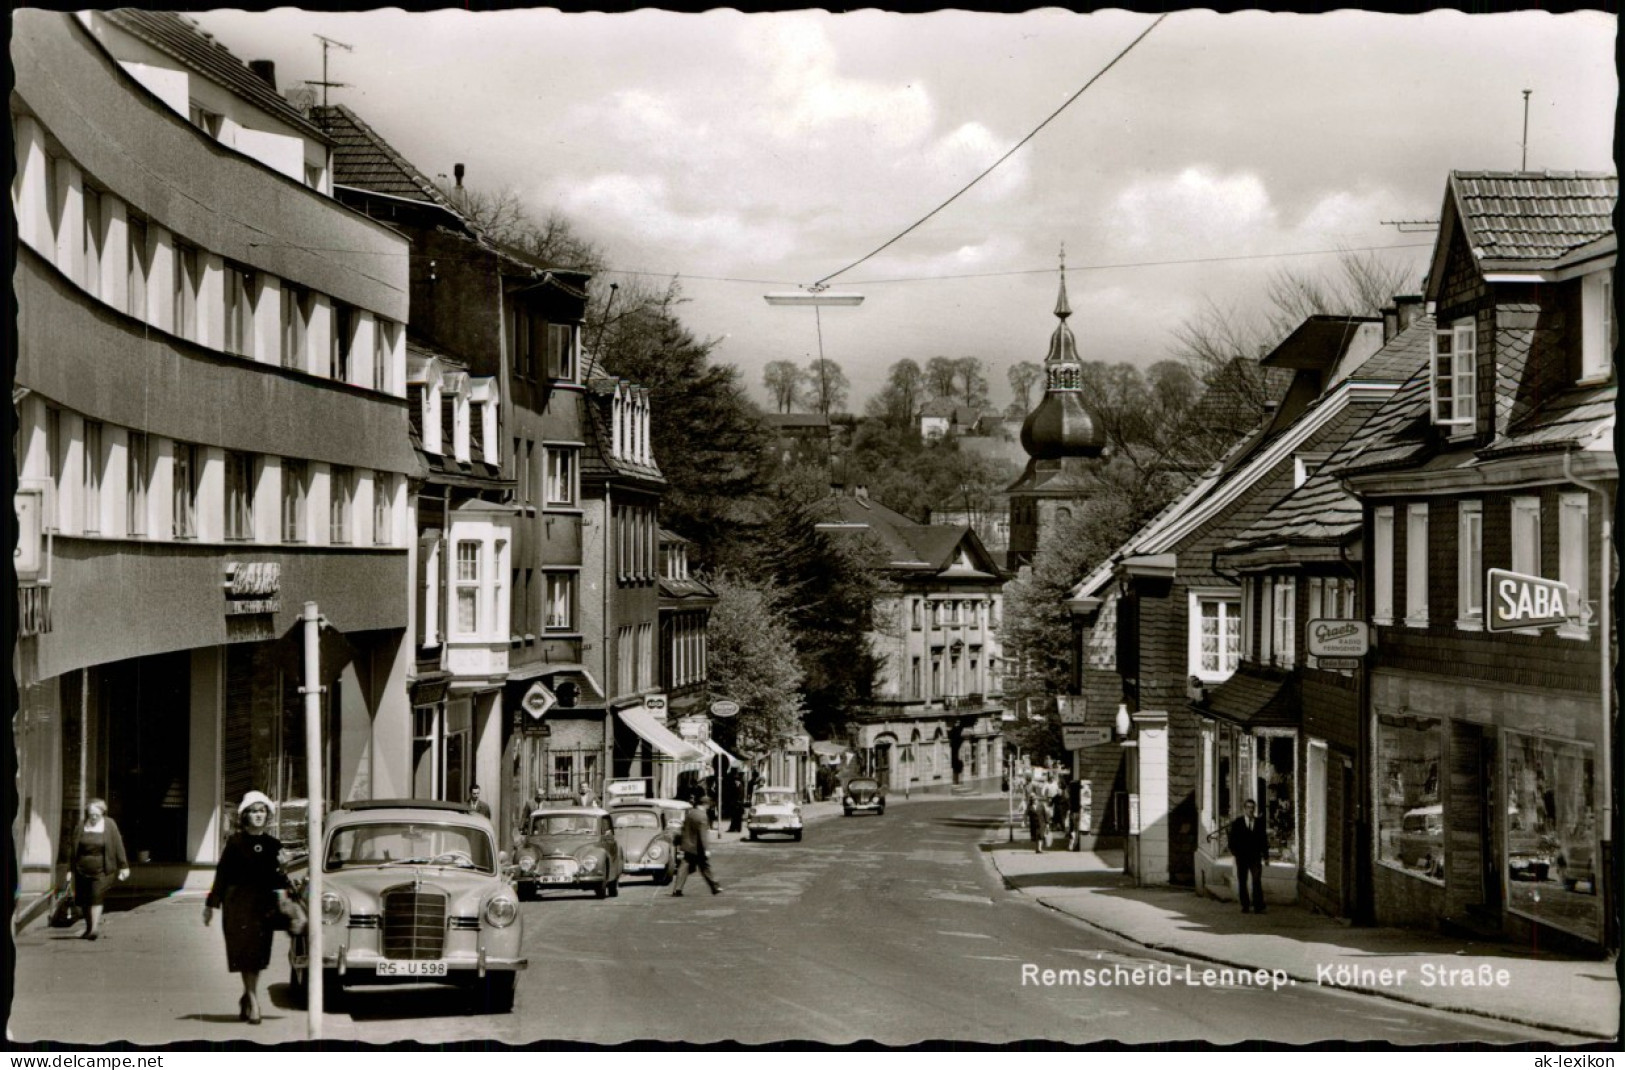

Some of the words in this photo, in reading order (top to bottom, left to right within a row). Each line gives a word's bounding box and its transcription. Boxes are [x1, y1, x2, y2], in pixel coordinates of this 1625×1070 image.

[1498, 579, 1566, 620] SABA
[1315, 623, 1359, 643] Graetz
[421, 963, 445, 974] 598
